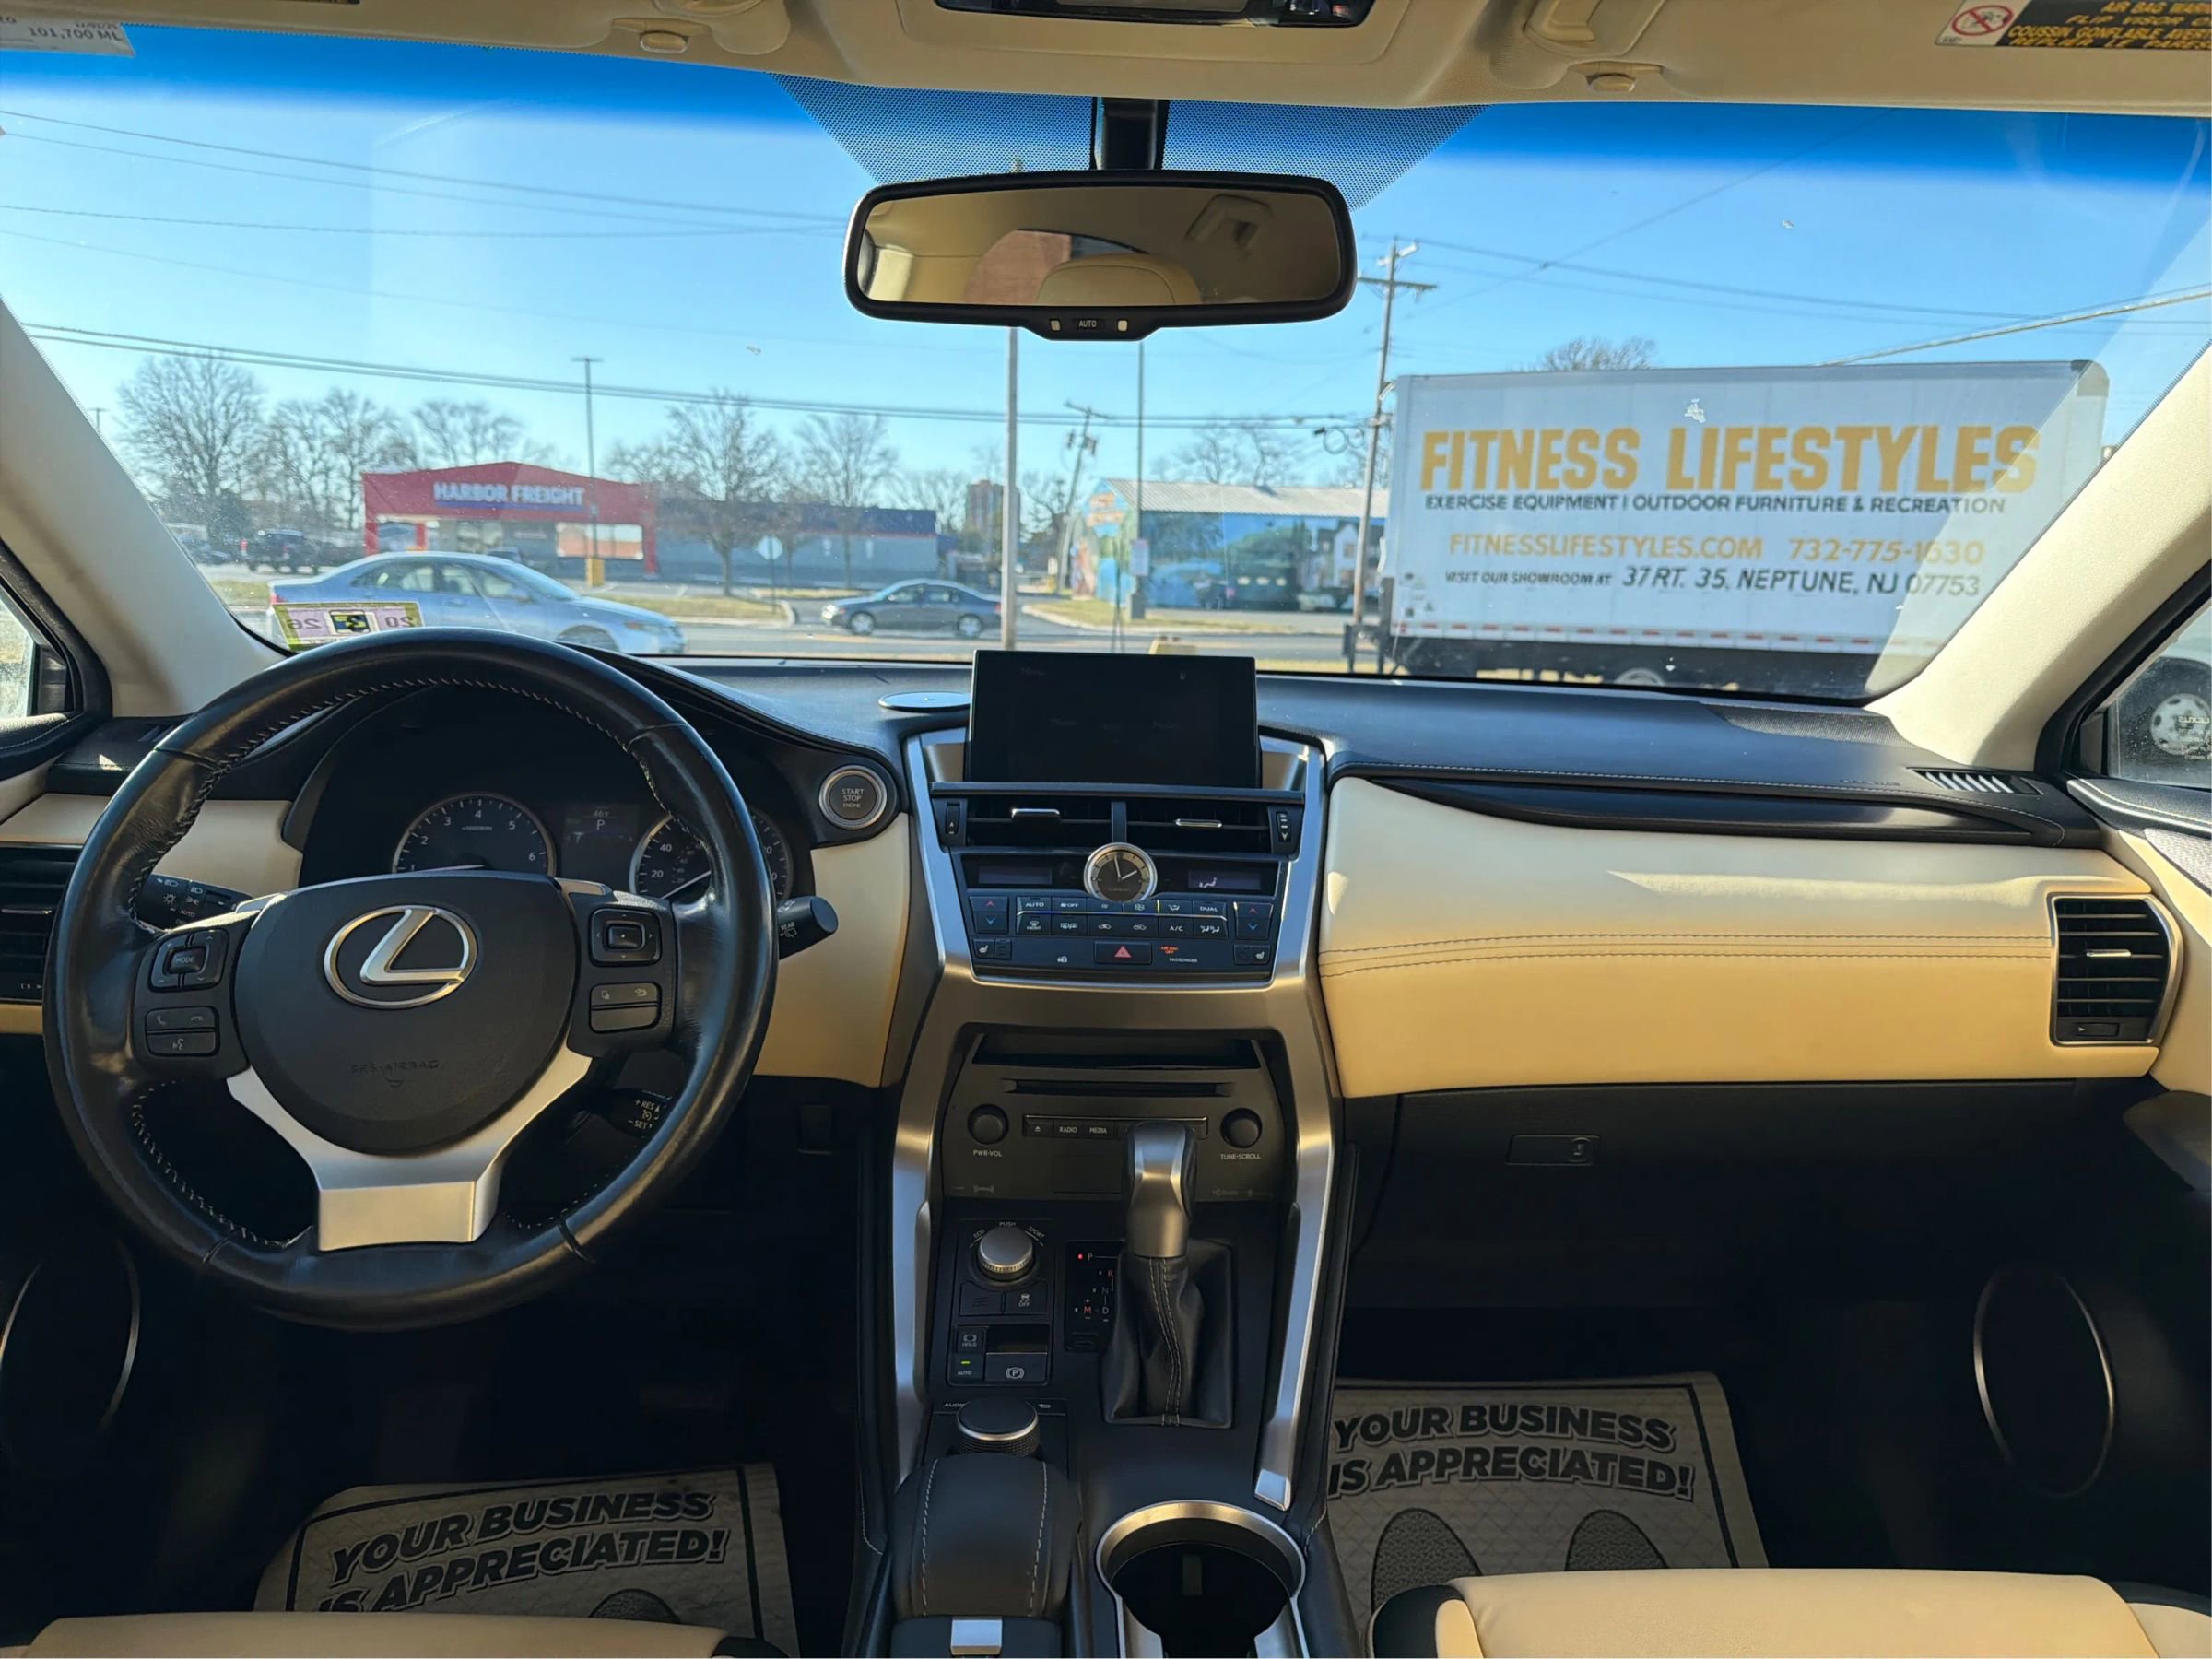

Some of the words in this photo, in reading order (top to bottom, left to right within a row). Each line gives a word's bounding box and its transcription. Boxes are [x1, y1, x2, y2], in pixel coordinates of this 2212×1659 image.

[1078, 319, 1097, 328] AUTO
[1420, 428, 1641, 491] FITNESS
[1666, 424, 2041, 492] LIFESTYLES
[433, 481, 508, 502] HARBOR
[511, 484, 585, 505] FREIGHT
[1425, 493, 1508, 510] EXERCISE
[1513, 494, 1619, 511] EQUIPMENT
[1632, 494, 1730, 512] OUTDOOR
[1735, 494, 1846, 512] FURNITURE
[1852, 495, 1865, 512] &
[1871, 496, 2006, 513] RECREATION
[1449, 532, 1763, 560] FITNESSLIFESTYLES.COM
[1445, 571, 1478, 584] VISIT
[1481, 571, 1509, 584] OUR
[1510, 571, 1595, 586] SHOWROOM
[1622, 565, 1651, 588] 37
[1866, 572, 1899, 594] NJ
[1905, 572, 1980, 596] 07753
[474, 810, 482, 818] 4
[443, 816, 452, 826] 3
[508, 820, 516, 830] 5
[419, 835, 429, 845] 2
[659, 843, 673, 853] 40
[528, 852, 536, 862] 6
[650, 869, 664, 878] 20
[175, 956, 194, 964] MODE
[1089, 1126, 1108, 1135] MEDIA
[1333, 1405, 1453, 1453] YOUR
[1460, 1403, 1677, 1453] BUSINESS
[1327, 1458, 1371, 1500] IS
[1375, 1445, 1694, 1502] APPRECIATED!
[331, 1513, 473, 1585] YOUR
[477, 1491, 715, 1540] BUSINESS
[371, 1528, 730, 1612] APPRECIATED!
